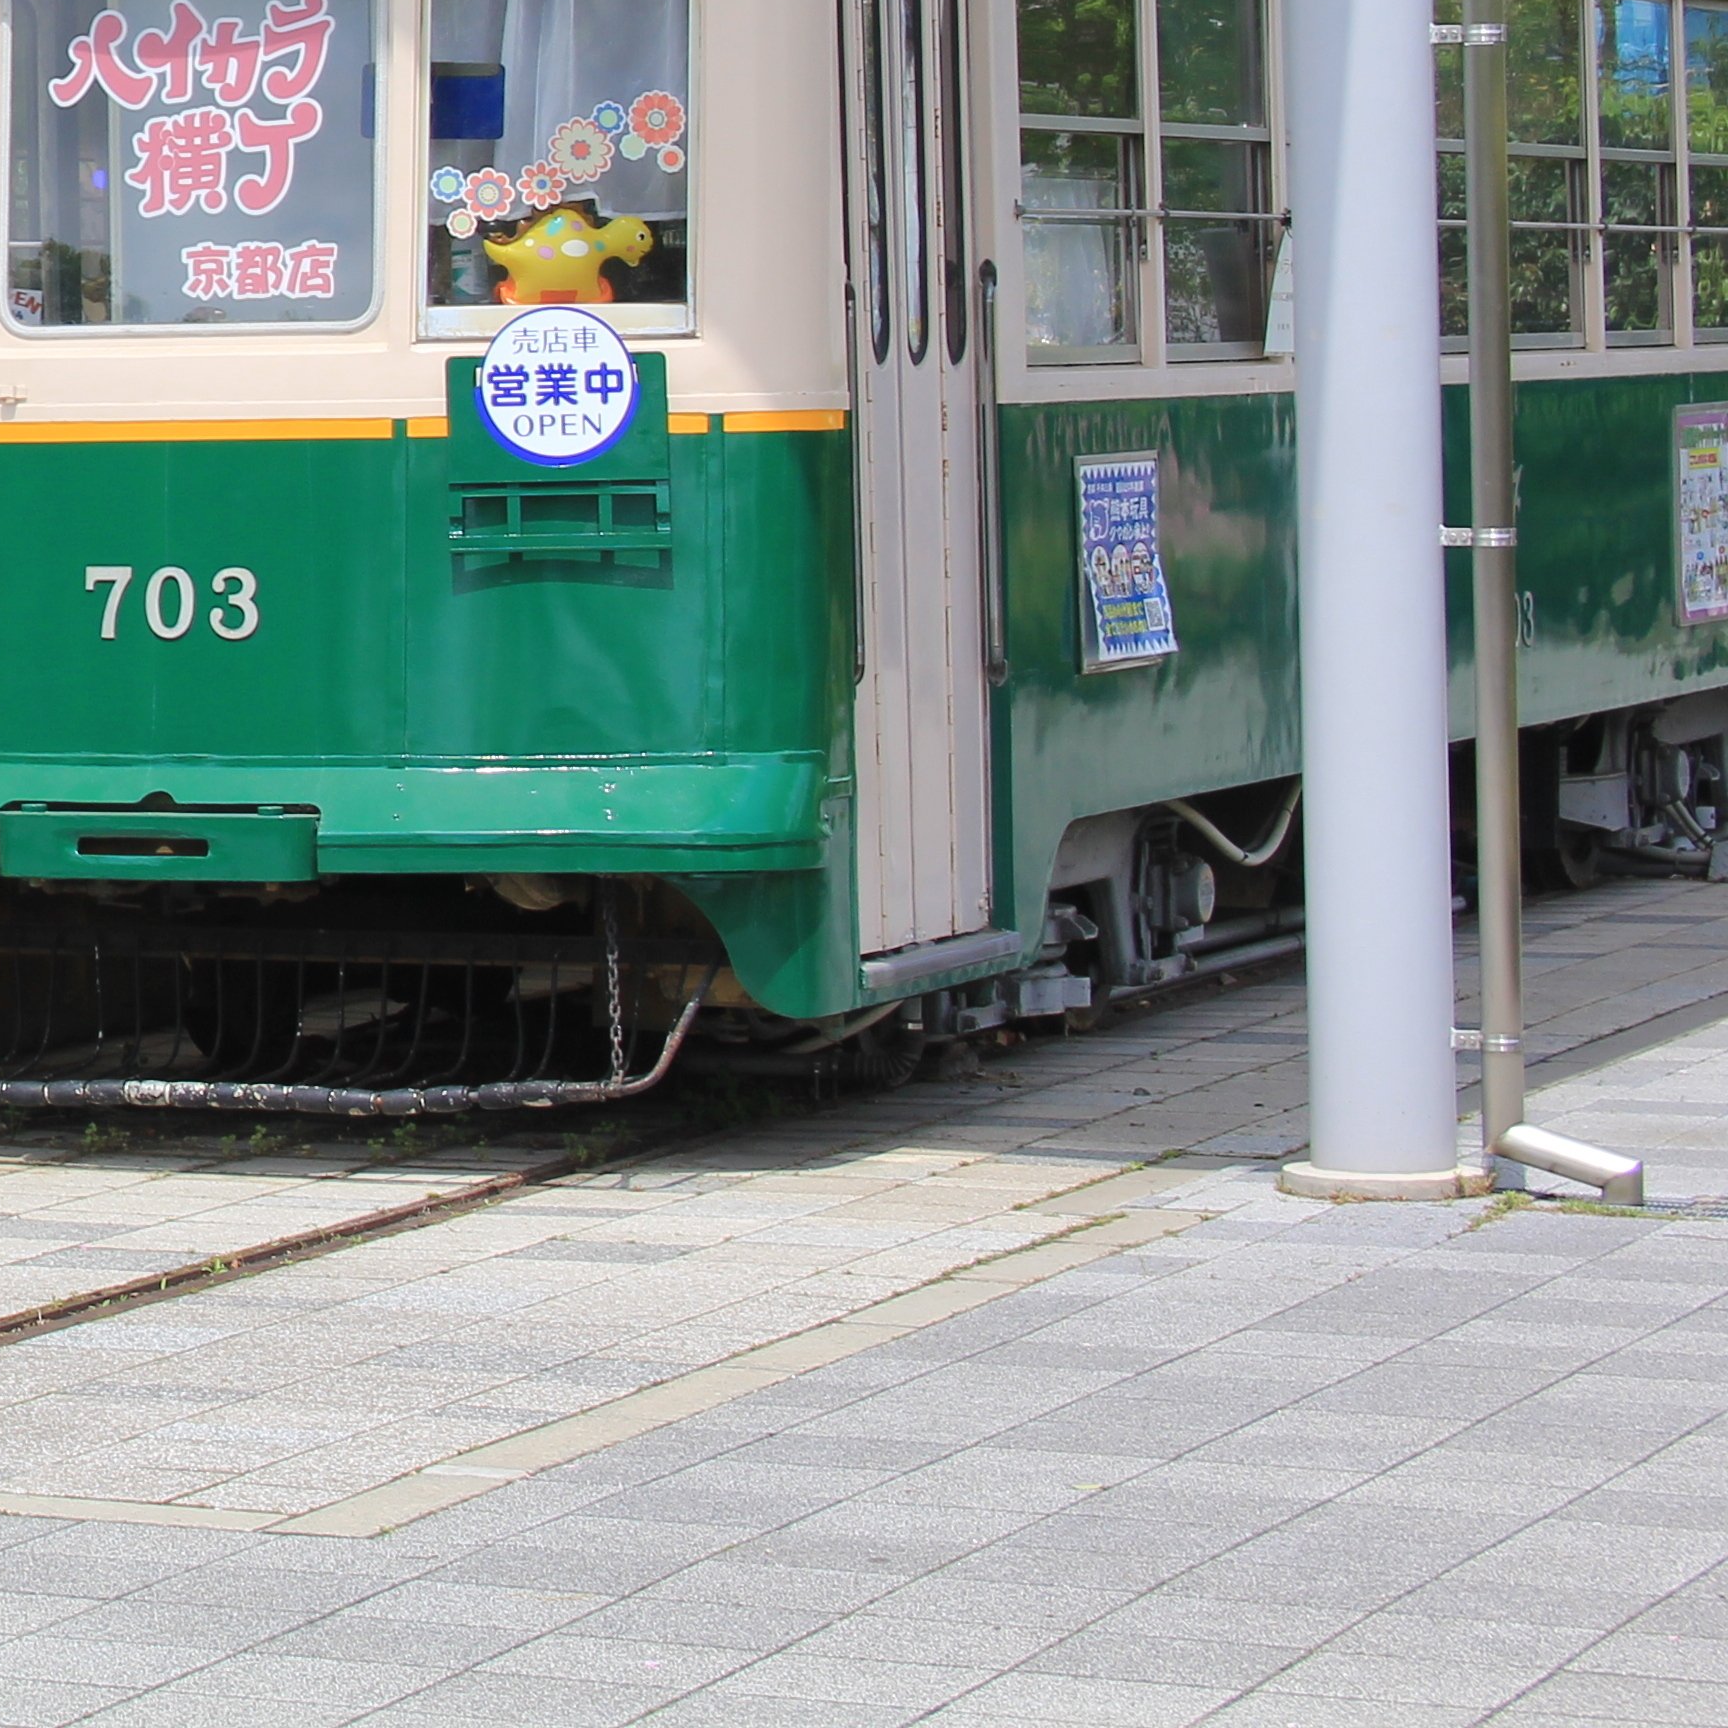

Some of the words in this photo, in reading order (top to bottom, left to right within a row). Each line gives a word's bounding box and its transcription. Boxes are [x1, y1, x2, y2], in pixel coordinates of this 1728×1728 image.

[125, 98, 322, 218] 横丁
[181, 240, 338, 299] 京都店
[512, 325, 599, 355] 売店車
[487, 361, 624, 408] 営業中
[513, 413, 604, 437] OPEN
[84, 565, 260, 641] 703
